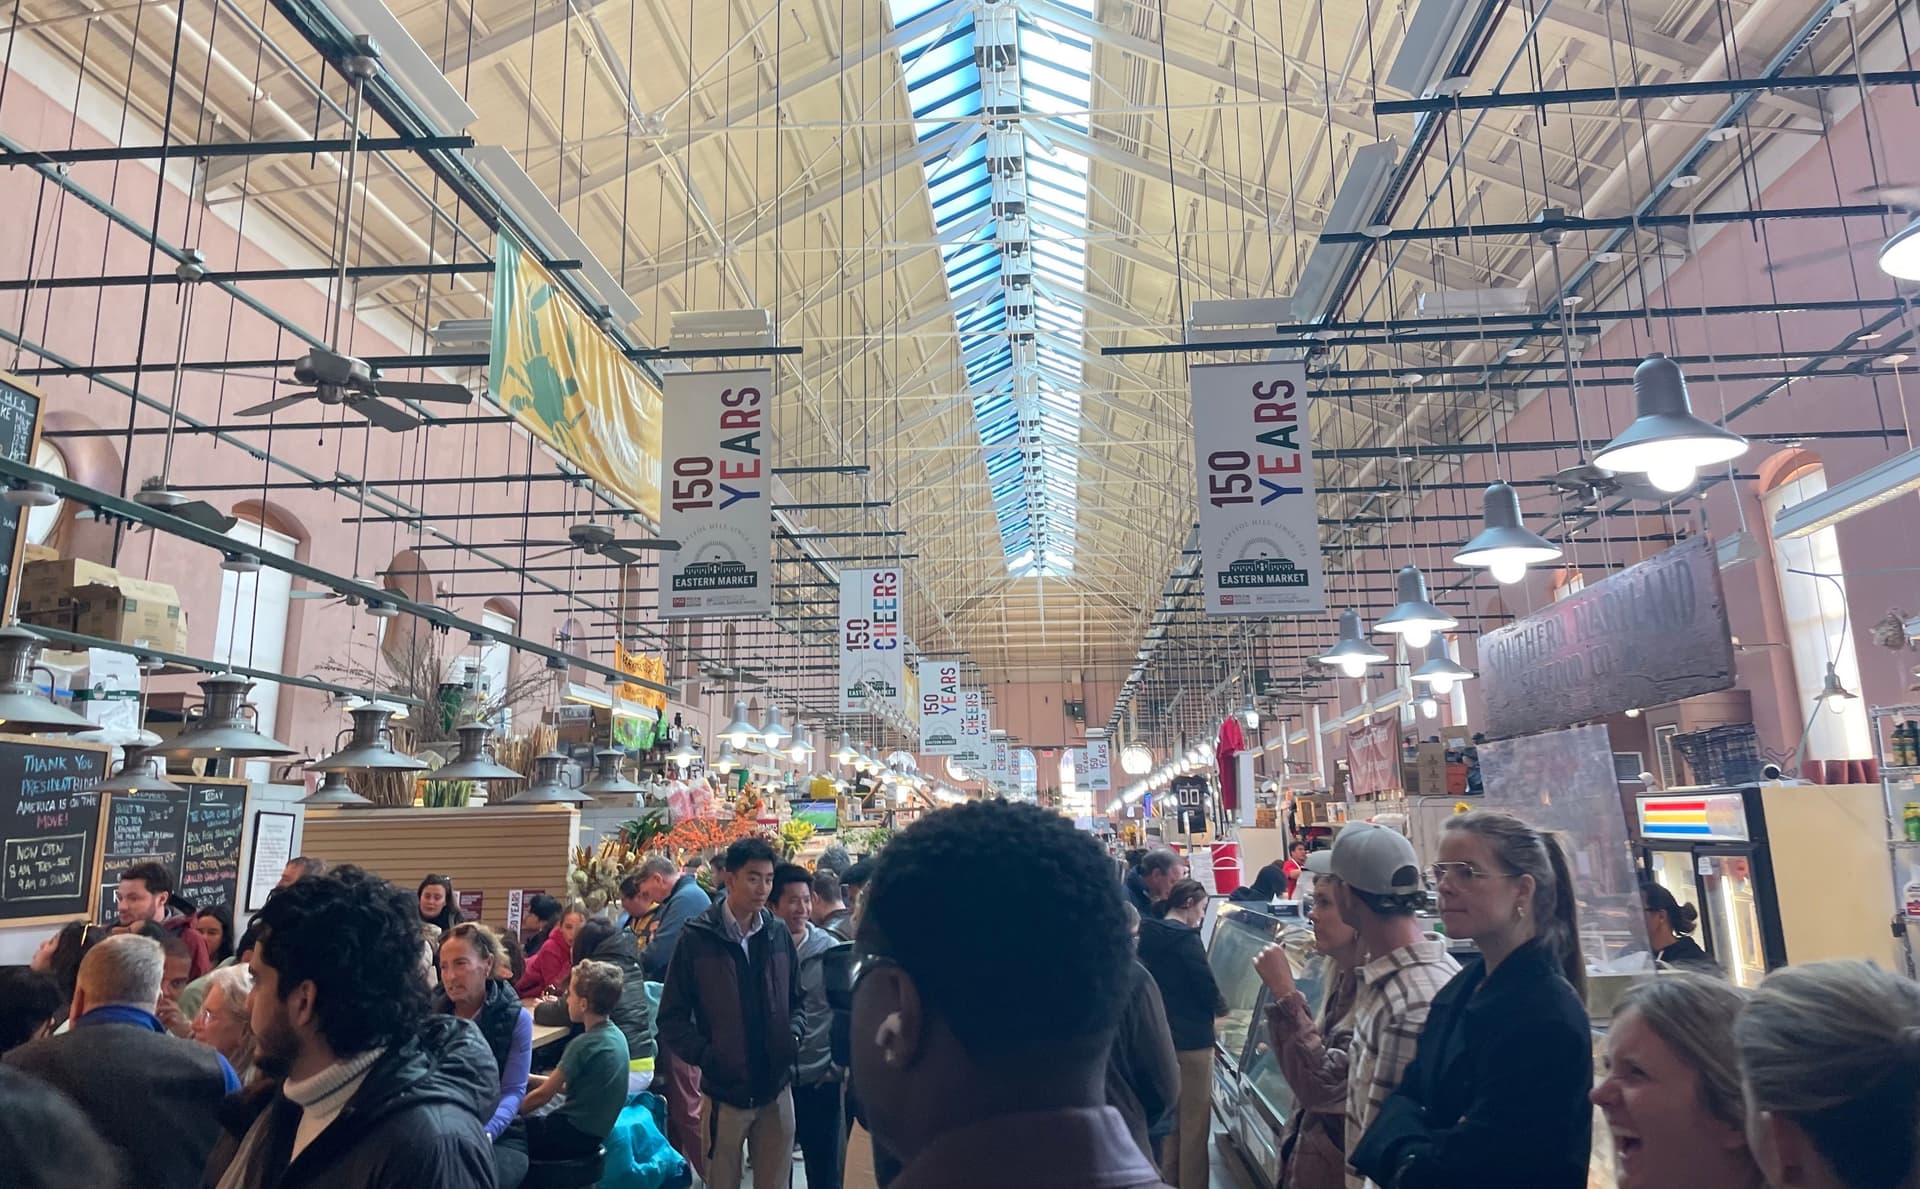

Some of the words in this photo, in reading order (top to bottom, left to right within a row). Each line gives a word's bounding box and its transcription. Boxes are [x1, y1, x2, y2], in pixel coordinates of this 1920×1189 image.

[719, 387, 761, 510] YEARS
[1252, 380, 1303, 506] YEARS
[673, 456, 713, 513] 150
[1208, 450, 1254, 508] 150
[675, 576, 715, 588] EASTERN
[717, 575, 754, 585] MARKET
[1221, 574, 1264, 585] EASTERN
[1266, 573, 1305, 583] MARKET
[873, 571, 897, 650] CHEERS
[1488, 613, 1567, 680] SOUTHERN
[1575, 557, 1698, 643] MARYLAND
[846, 618, 870, 652] 150
[924, 694, 939, 716] 150
[940, 667, 957, 715] YEARS
[965, 693, 979, 736] CHEERS
[23, 754, 67, 772] THANK
[21, 776, 73, 796] PRESIDENT
[16, 800, 55, 815] AMERICA
[60, 799, 66, 810] IS
[81, 796, 97, 807] THE
[36, 812, 69, 829] MOVE!
[17, 845, 38, 861] NOW
[41, 843, 64, 857] OPEN
[509, 891, 521, 919] YEARS
